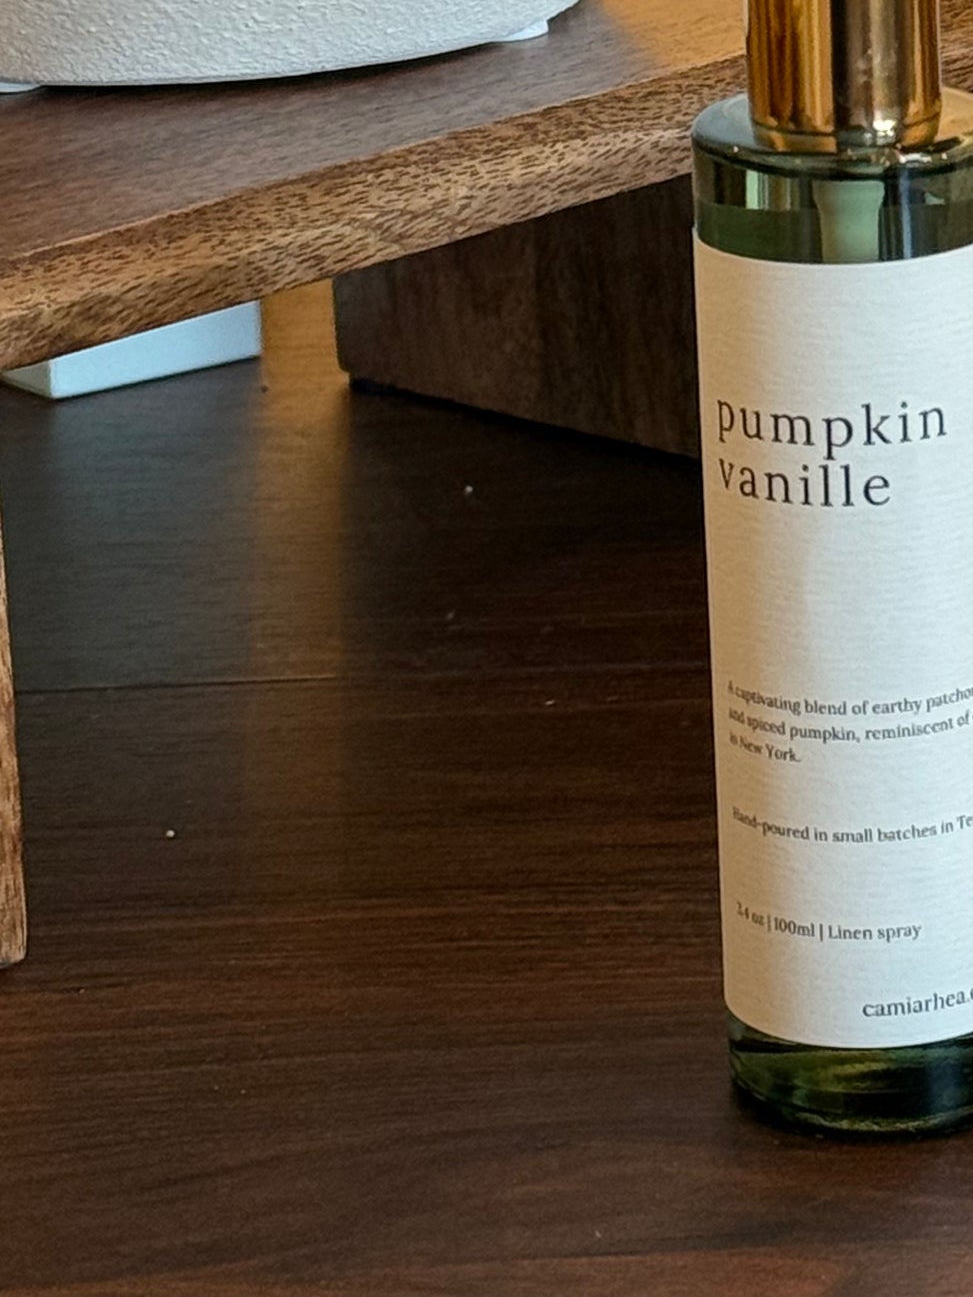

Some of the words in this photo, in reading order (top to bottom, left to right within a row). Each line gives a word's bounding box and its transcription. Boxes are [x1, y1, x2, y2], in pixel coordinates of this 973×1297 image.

[717, 399, 948, 461] pumpkin
[718, 457, 892, 508] vanille
[735, 686, 801, 716] captivating
[804, 699, 847, 716] blend
[852, 699, 870, 715] of
[872, 698, 922, 715] earthy
[729, 707, 745, 725] and
[746, 715, 786, 736] spiced
[790, 726, 861, 745] pumpkin,
[865, 718, 954, 740] reminiscent
[957, 710, 970, 727] of
[740, 736, 763, 755] New
[765, 743, 802, 763] York.
[732, 806, 811, 841] Hand-poured
[814, 827, 828, 842] in
[832, 828, 873, 843] small
[877, 824, 937, 843] batches
[940, 819, 954, 834] in
[752, 912, 765, 927] oz
[774, 916, 815, 938] 100ml
[828, 924, 872, 941] Linen
[877, 923, 922, 943] spray
